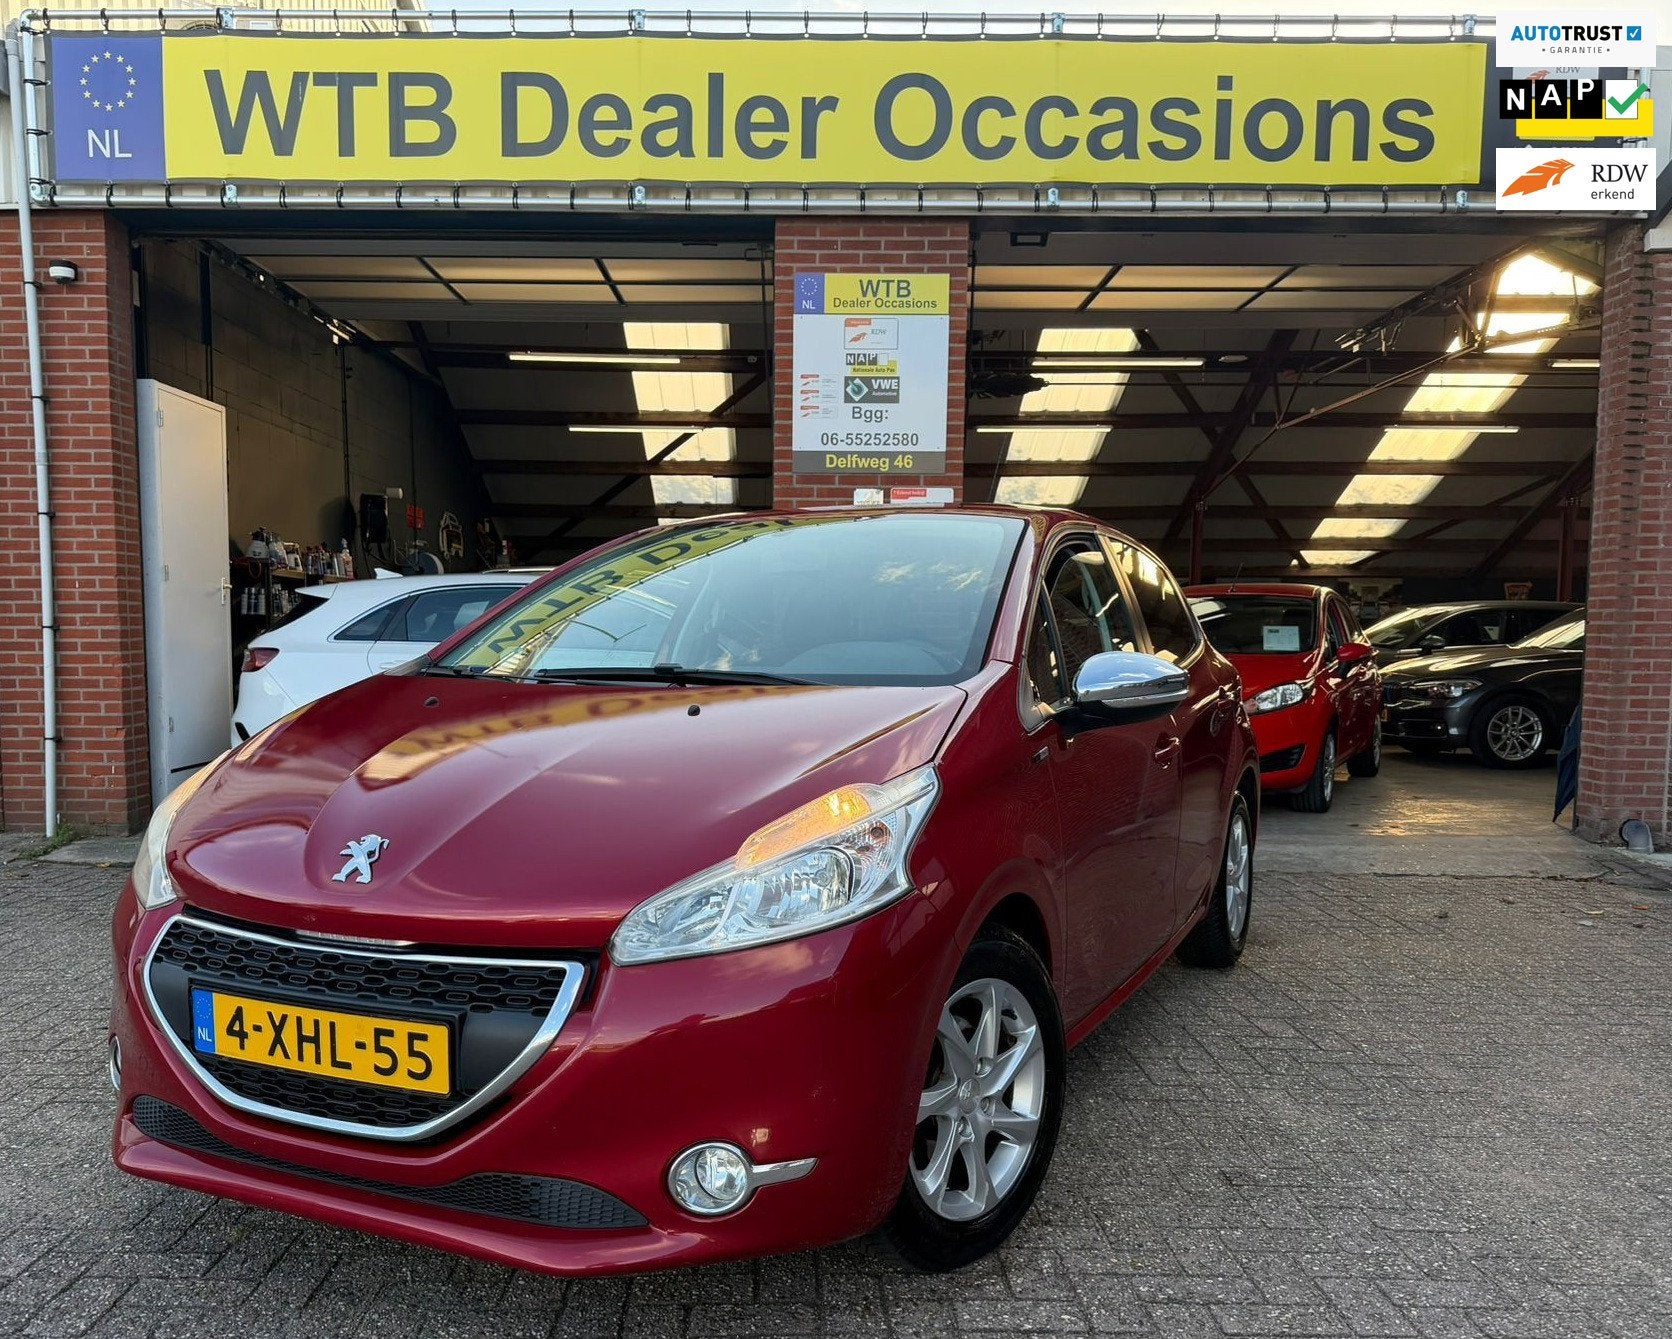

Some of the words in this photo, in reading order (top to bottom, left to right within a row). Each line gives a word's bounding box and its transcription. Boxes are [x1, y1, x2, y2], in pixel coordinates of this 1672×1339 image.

[203, 69, 458, 159] WTB
[501, 70, 839, 161] Dealer
[873, 71, 1437, 163] Occasions
[87, 128, 133, 159] NL
[859, 279, 912, 298] WTB
[802, 300, 816, 309] NL
[832, 297, 872, 309] Dealer
[875, 297, 938, 309] Occasions
[847, 353, 876, 364] NAP
[871, 379, 899, 390] VWE
[851, 406, 889, 422] Bgg:
[820, 432, 919, 447] 06-55252580
[825, 455, 890, 471] Delfweg
[894, 455, 914, 469] 46
[197, 1026, 213, 1043] NL
[225, 1005, 433, 1081] 4-XHL-55
